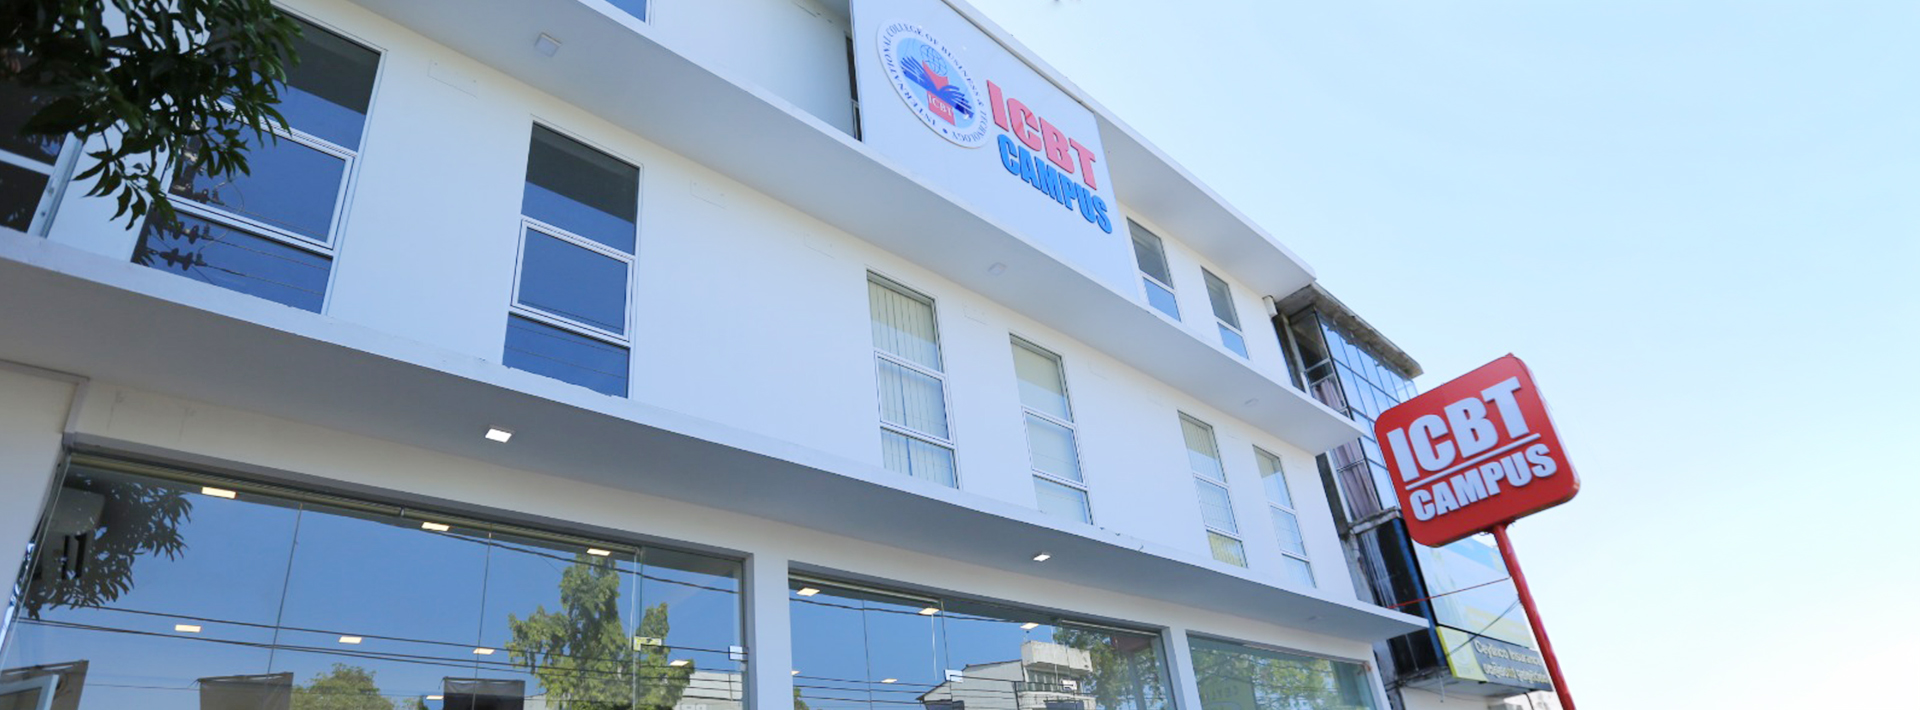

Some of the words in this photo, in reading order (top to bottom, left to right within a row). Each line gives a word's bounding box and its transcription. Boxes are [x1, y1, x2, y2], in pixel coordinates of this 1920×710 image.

[886, 23, 924, 37] COLLEGE
[882, 35, 937, 126] INTERNATIONAL
[928, 94, 953, 117] ICBT
[941, 45, 980, 97] BUSINESS
[951, 110, 989, 143] TECHNOLOGY
[986, 79, 1097, 191] ICBT
[997, 133, 1113, 235] CAMPUS
[1386, 376, 1530, 483] ICBT
[1409, 443, 1558, 522] CAMPUS
